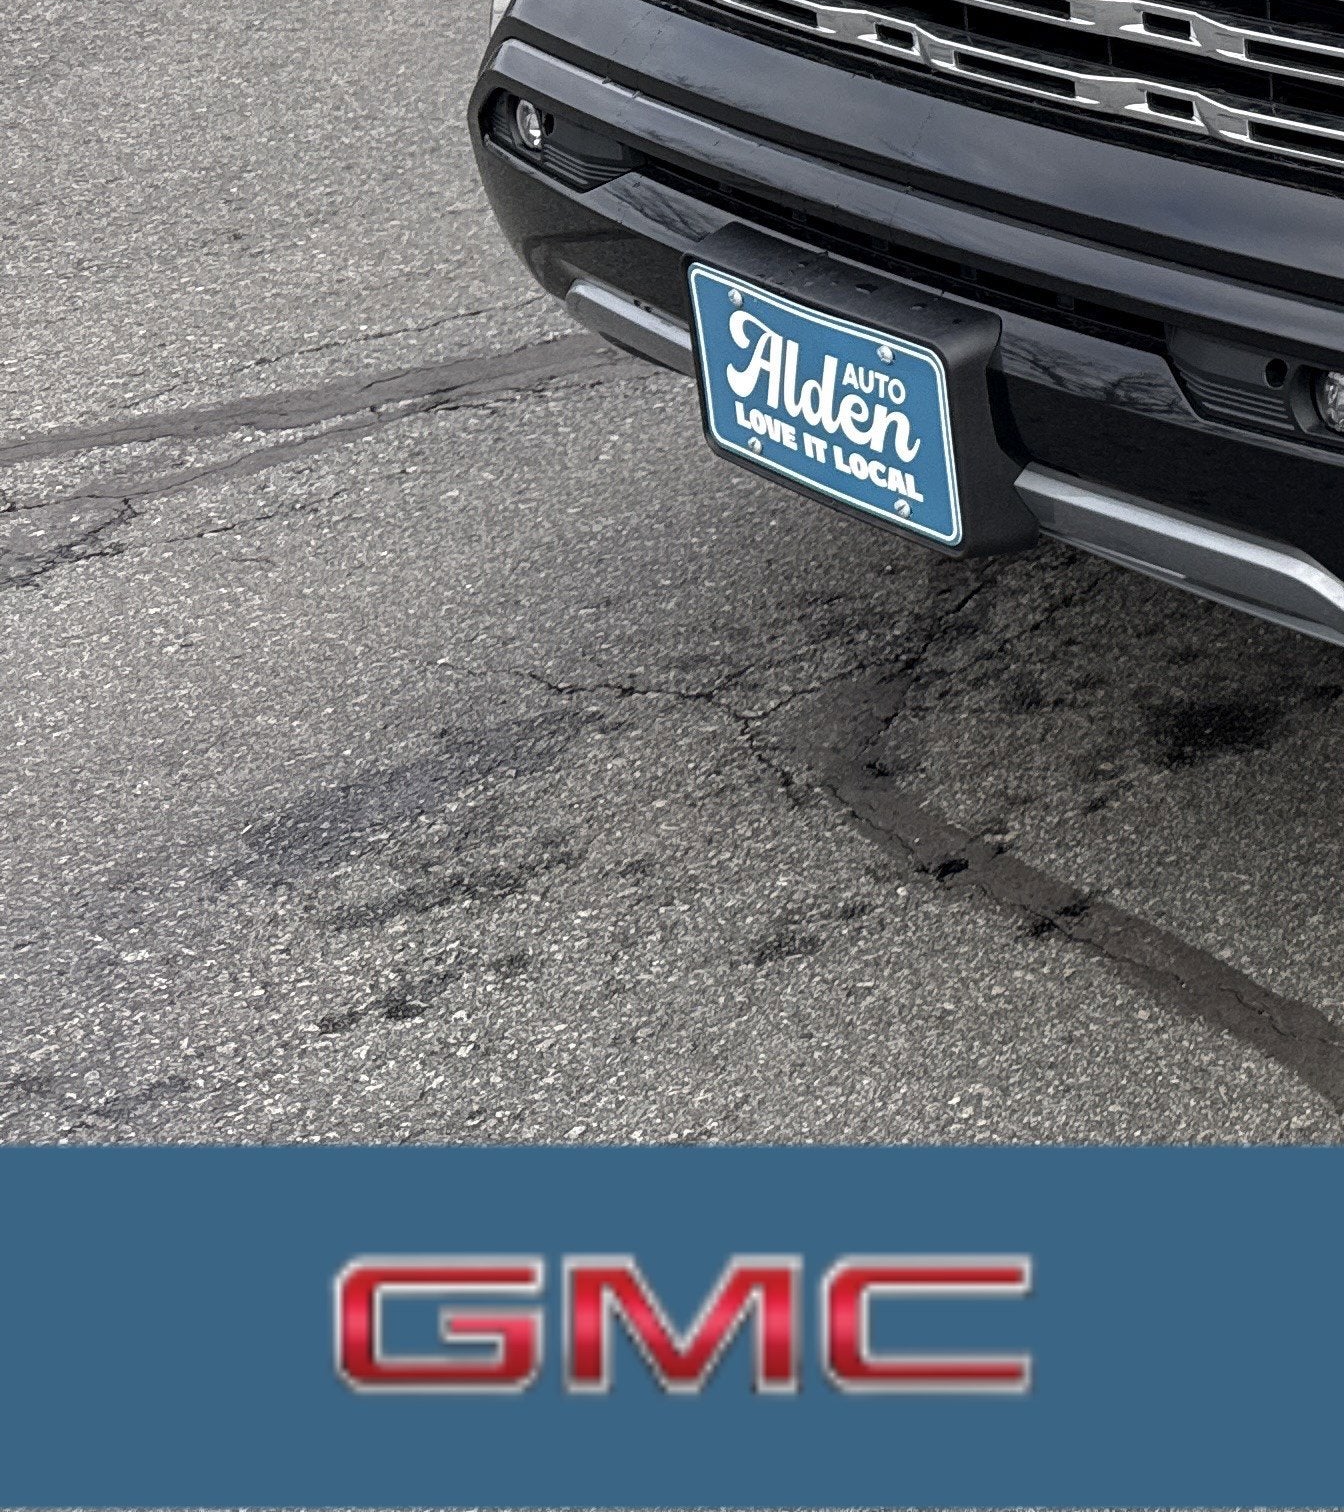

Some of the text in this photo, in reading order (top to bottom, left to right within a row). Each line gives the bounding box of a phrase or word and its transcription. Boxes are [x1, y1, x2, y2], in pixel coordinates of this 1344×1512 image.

[726, 310, 921, 463] Alden AUTO
[735, 401, 924, 503] LOVE IT LOCAL
